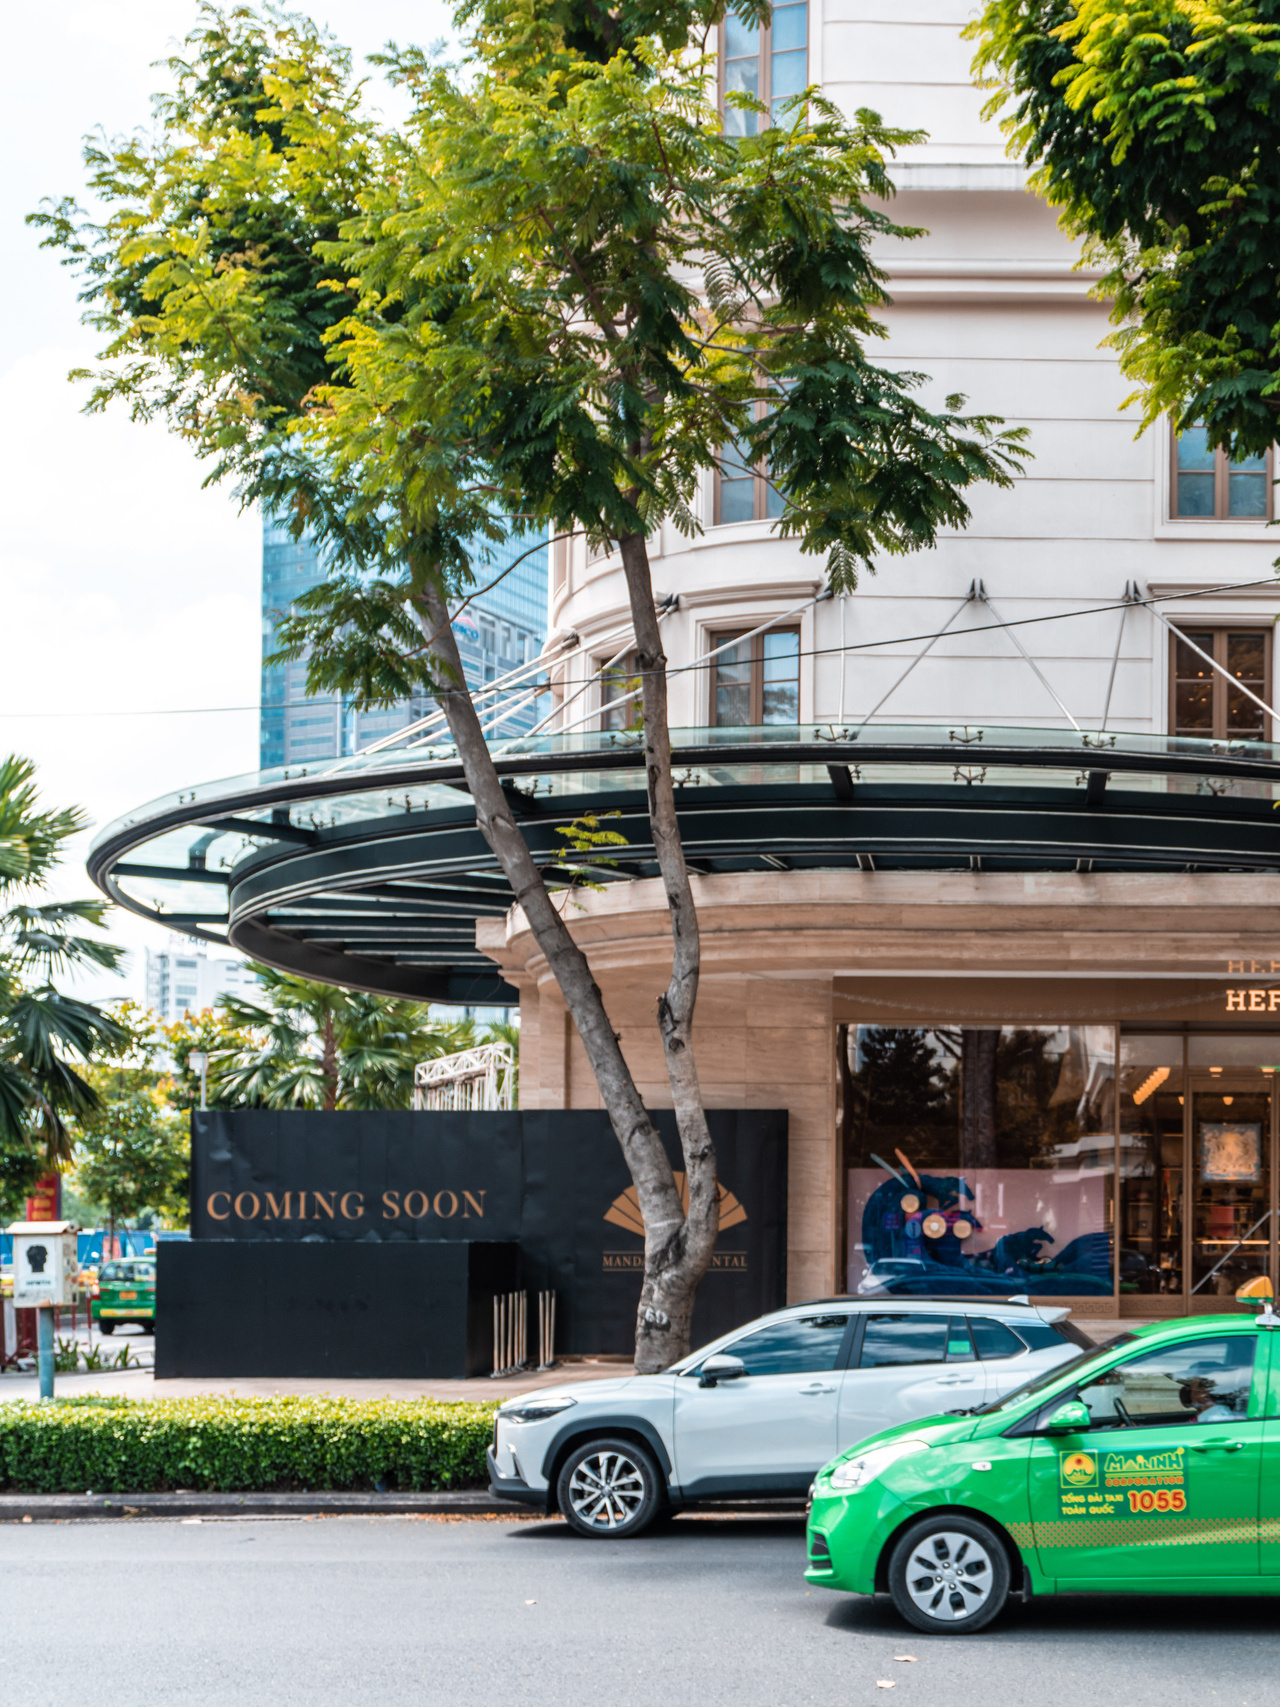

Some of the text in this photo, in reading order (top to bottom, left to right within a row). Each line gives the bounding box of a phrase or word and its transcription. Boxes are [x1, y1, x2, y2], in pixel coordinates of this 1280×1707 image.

[206, 1190, 487, 1221] COMING SOON
[602, 1256, 645, 1267] MAND
[645, 1307, 668, 1325] 60
[1105, 1476, 1184, 1487] CORPORATION
[1104, 1494, 1124, 1502] TAXI
[1127, 1490, 1187, 1513] 1055
[1061, 1504, 1086, 1515] TOÀN
